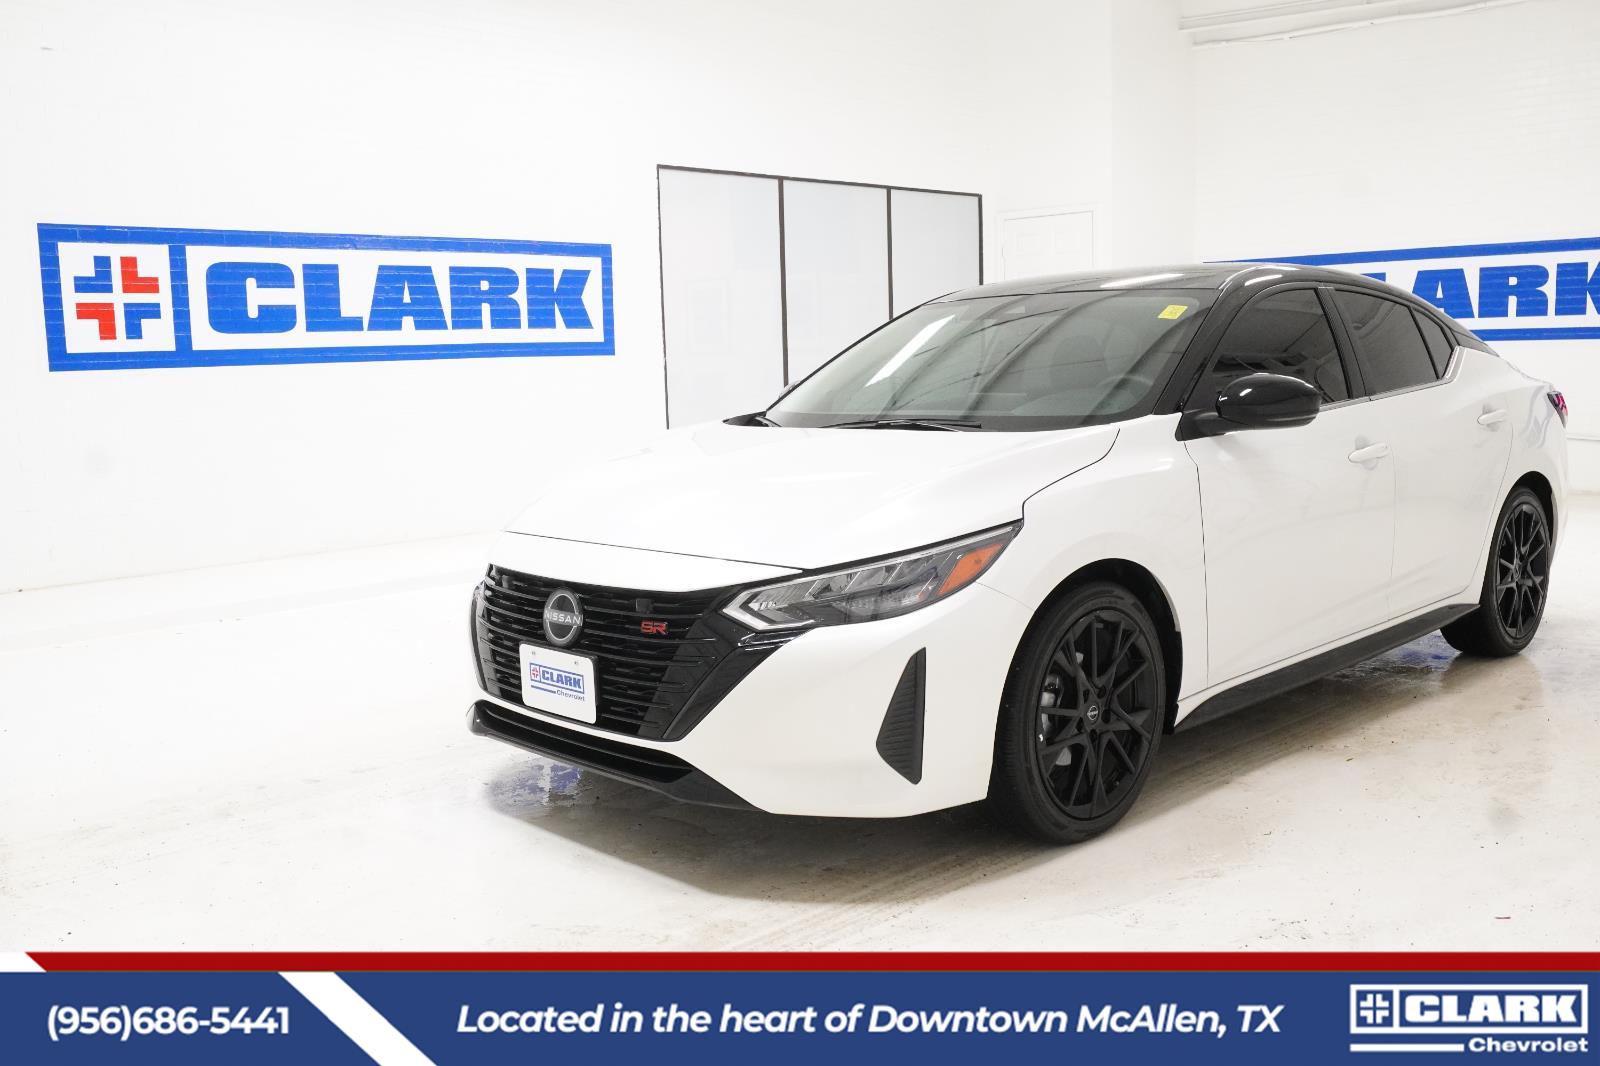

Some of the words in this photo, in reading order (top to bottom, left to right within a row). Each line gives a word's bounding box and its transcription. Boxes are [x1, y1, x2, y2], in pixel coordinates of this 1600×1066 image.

[206, 261, 594, 334] CLARK
[1360, 261, 1600, 319] ARK
[544, 608, 580, 625] NISSAN
[640, 620, 668, 635] SR
[541, 669, 582, 689] CLARK
